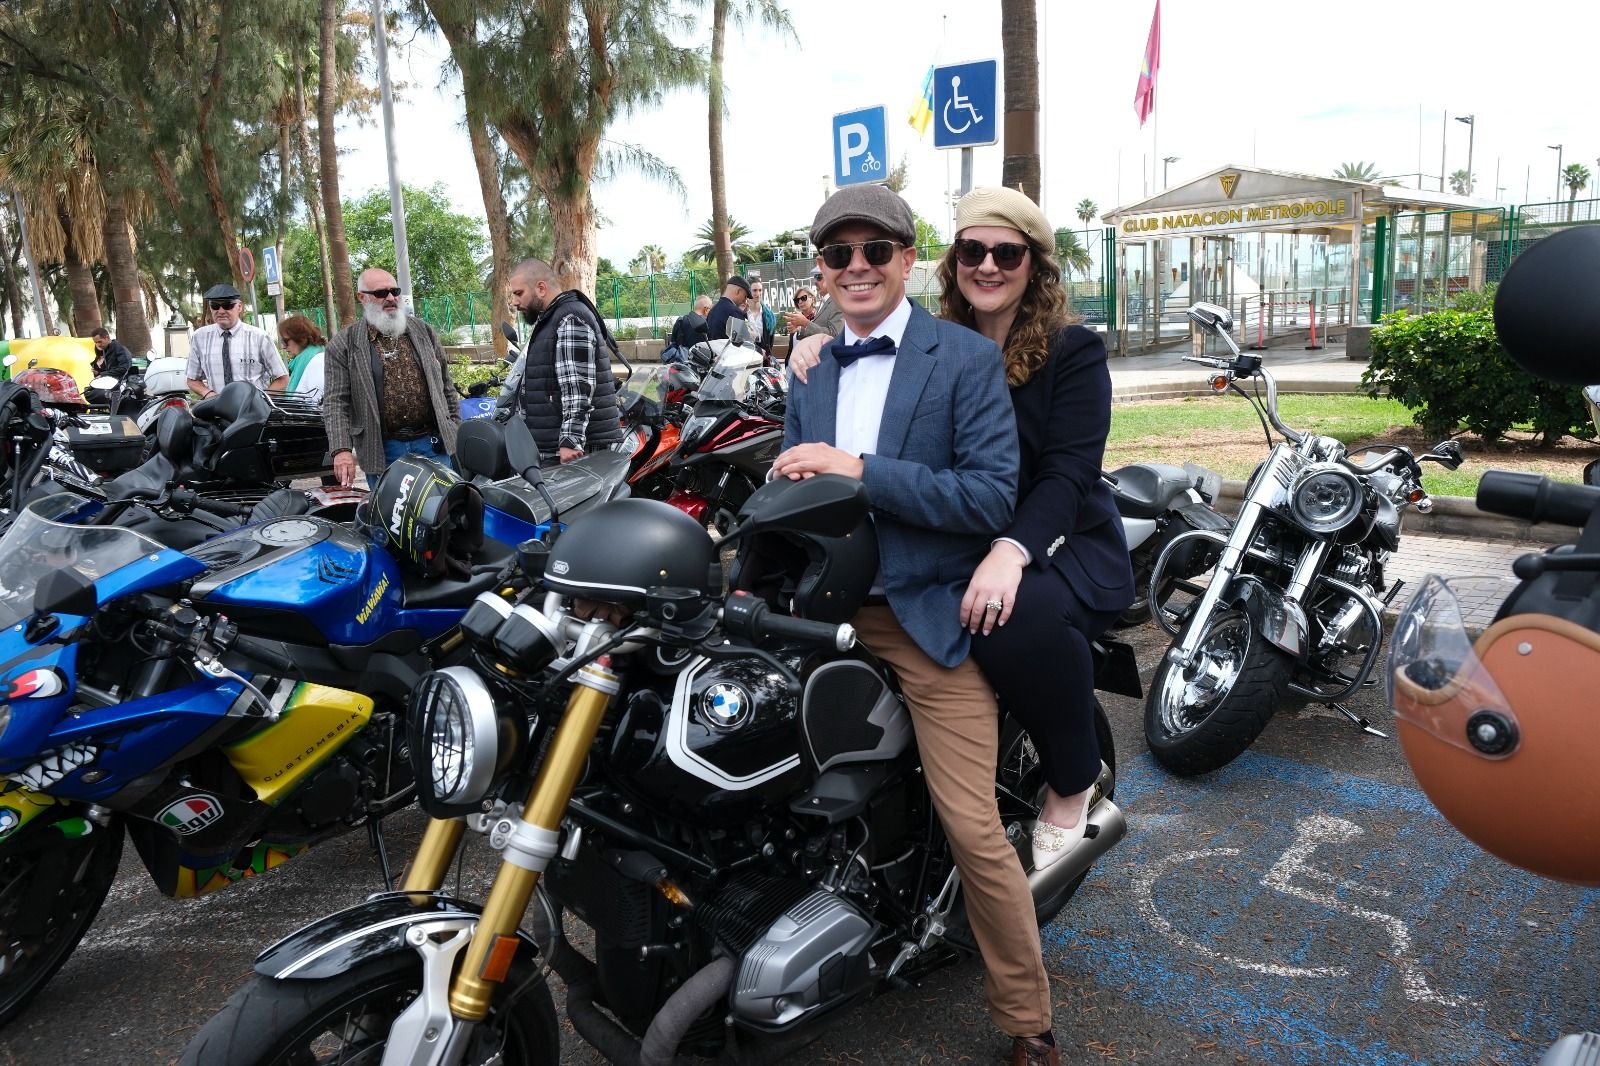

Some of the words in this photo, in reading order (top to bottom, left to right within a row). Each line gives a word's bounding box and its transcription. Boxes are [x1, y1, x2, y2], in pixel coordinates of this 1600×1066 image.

[840, 123, 869, 177] P
[1122, 217, 1158, 233] CLUB
[1161, 209, 1243, 229] NATACION
[1246, 199, 1345, 222] METROPOLE
[265, 253, 273, 279] P
[390, 473, 415, 536] NAVA
[263, 703, 364, 783] CUSTOMSBIKE
